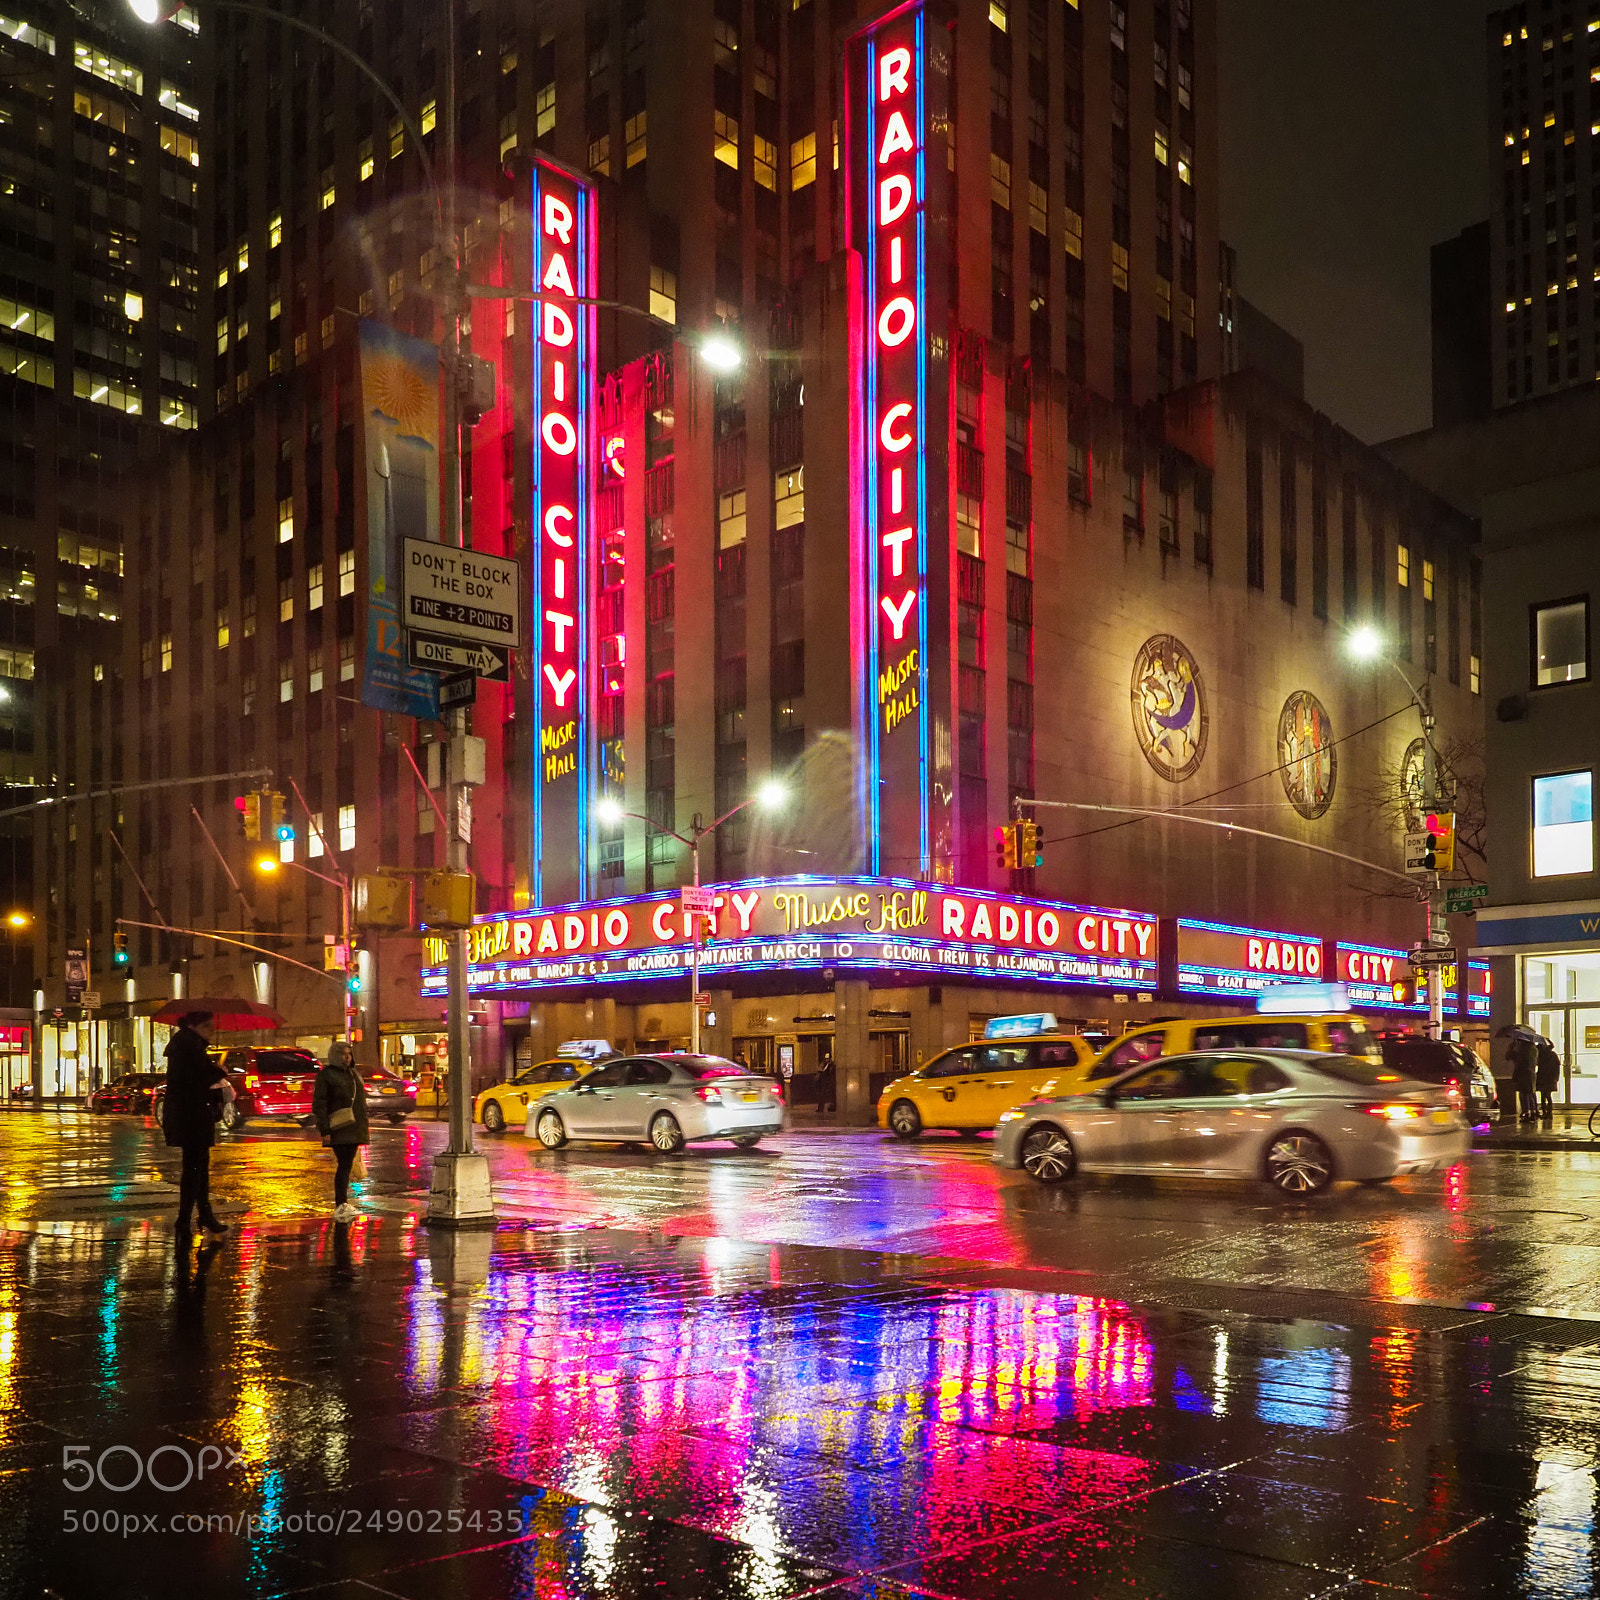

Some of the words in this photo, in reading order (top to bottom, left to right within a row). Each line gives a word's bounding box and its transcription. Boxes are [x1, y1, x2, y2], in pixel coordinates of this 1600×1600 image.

[877, 47, 915, 347] RADIO
[541, 194, 577, 456] RADIO
[880, 403, 917, 639] CITY
[411, 551, 456, 574] DON'T
[462, 562, 511, 585] BLOCK
[431, 573, 460, 593] THE
[466, 581, 493, 600] BOX
[414, 598, 441, 617] FINE
[446, 607, 465, 622] +2
[469, 611, 509, 631] POINTS
[543, 504, 577, 707] CITY
[424, 643, 454, 661] ONE
[466, 651, 494, 670] WAY
[878, 649, 919, 704] MUSIC
[885, 687, 920, 735] HALL
[541, 720, 577, 755] MUSIC
[545, 753, 577, 783] HALL
[773, 891, 869, 932] Music
[864, 890, 929, 933] Hall
[1449, 889, 1486, 899] AMERICAS
[1451, 902, 1459, 912] 6
[467, 921, 510, 963] Hall
[513, 909, 629, 956] RADIO
[941, 898, 1060, 946] RADIO
[1077, 916, 1152, 956] CITY
[627, 952, 679, 971] RICARDO
[684, 947, 753, 966] MONTANER
[761, 943, 821, 960] MARCH
[833, 942, 853, 957] 10
[882, 944, 931, 962] GLORIA
[938, 949, 969, 965] TREVI
[975, 952, 991, 967] VS.
[997, 954, 1055, 973] ALEJANDRA
[1059, 961, 1098, 976] GUZMAN
[1102, 964, 1132, 979] MARCH
[1136, 968, 1145, 980] 17
[1247, 938, 1320, 974] RADIO
[1348, 953, 1393, 983] CITY
[1436, 952, 1452, 960] WAY
[510, 966, 532, 981] PHIL
[537, 963, 573, 979] MARCH
[577, 962, 586, 975] 2
[601, 960, 609, 973] 3
